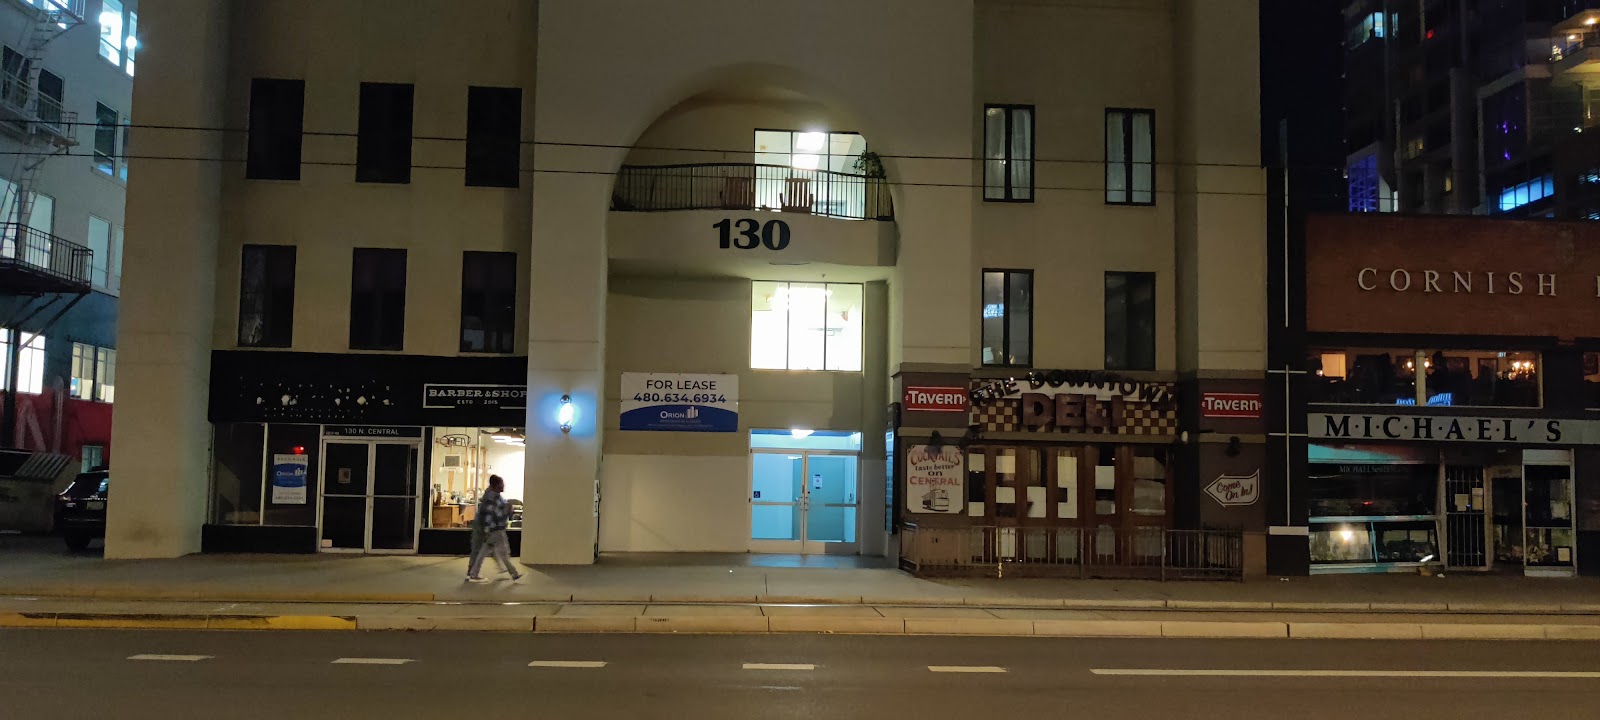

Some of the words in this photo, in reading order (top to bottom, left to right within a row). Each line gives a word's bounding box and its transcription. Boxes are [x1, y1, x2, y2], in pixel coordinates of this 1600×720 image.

[713, 218, 791, 251] 130
[1357, 267, 1557, 296] CORNISH
[646, 380, 673, 390] FOR
[677, 380, 716, 391] LEASE
[970, 376, 1020, 407] THE
[1027, 370, 1179, 413] DOWNTOWN
[633, 392, 726, 403] 480.634.6934
[660, 411, 685, 419] ORION
[1021, 393, 1124, 430] DELI
[910, 476, 960, 487] CENTRAL
[1216, 481, 1241, 494] Come
[1225, 490, 1239, 501] On
